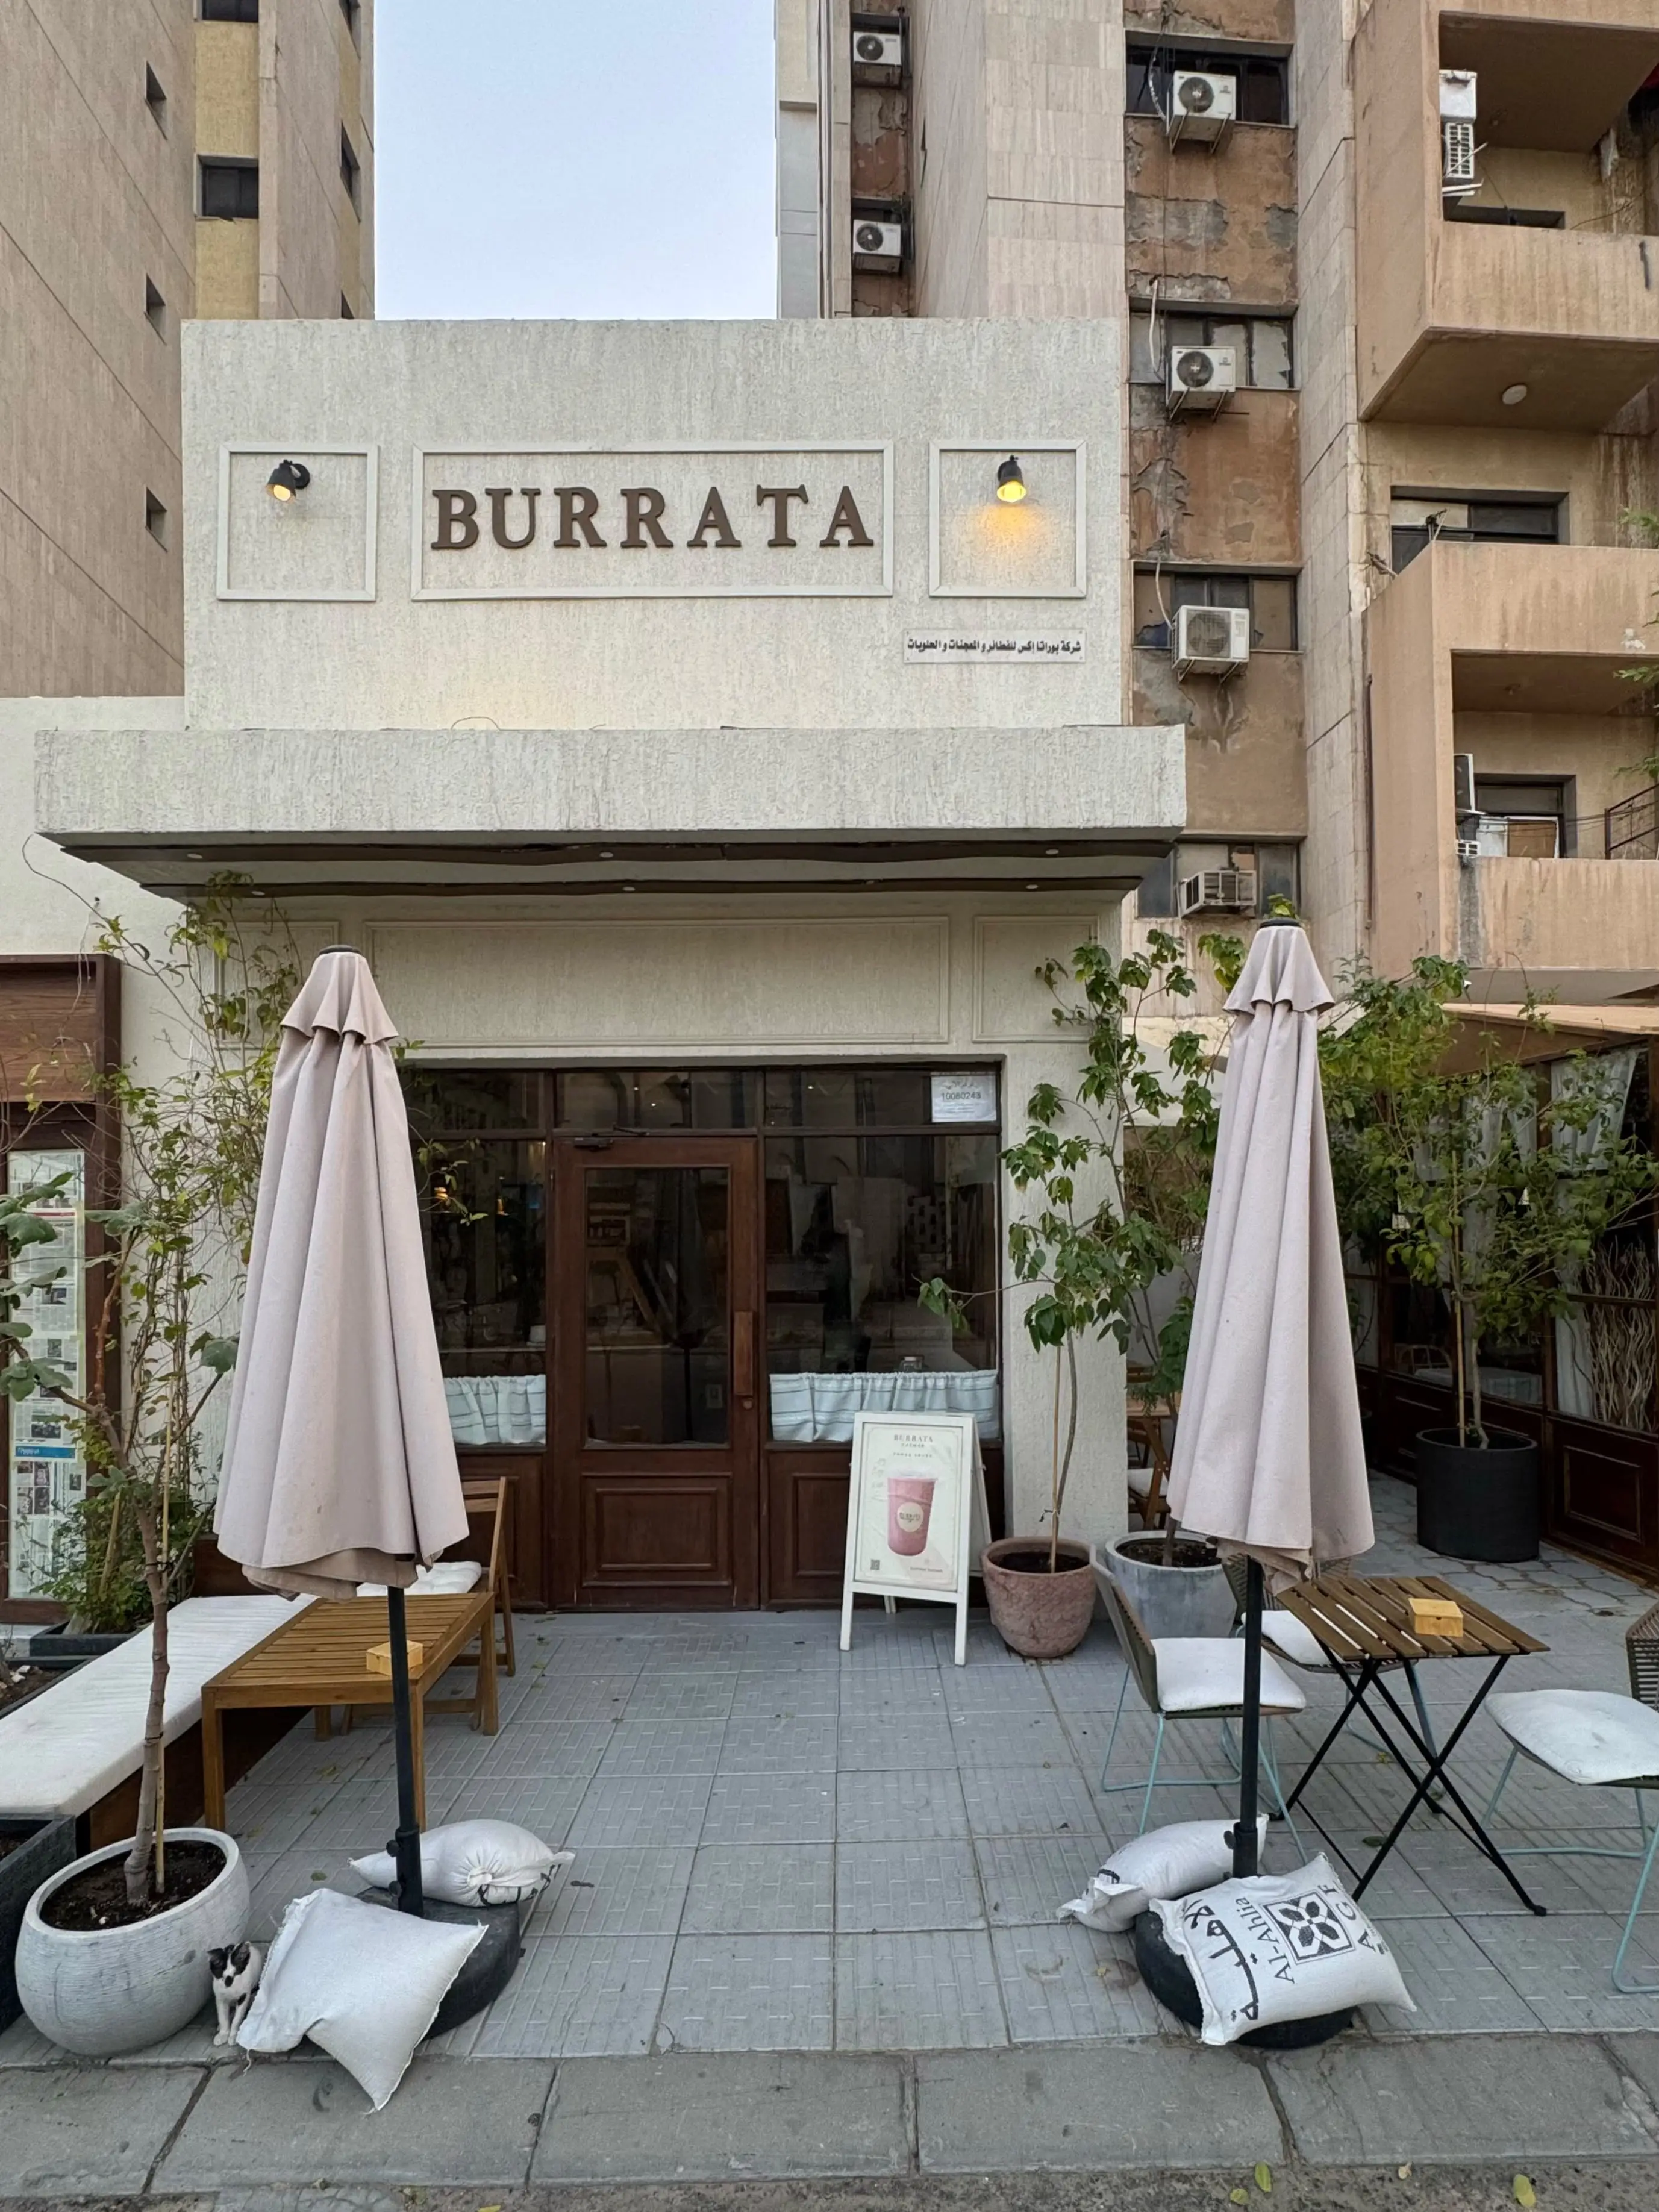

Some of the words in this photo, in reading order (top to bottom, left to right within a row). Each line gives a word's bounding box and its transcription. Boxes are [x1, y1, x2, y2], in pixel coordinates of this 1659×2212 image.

[431, 485, 874, 549] BURRATA
[1017, 641, 1034, 654] إكس
[1036, 640, 1059, 655] بوراتا
[1061, 640, 1081, 654] شركة
[894, 1434, 933, 1442] BURRATA
[1235, 1896, 1295, 1984] Al-Ahlia
